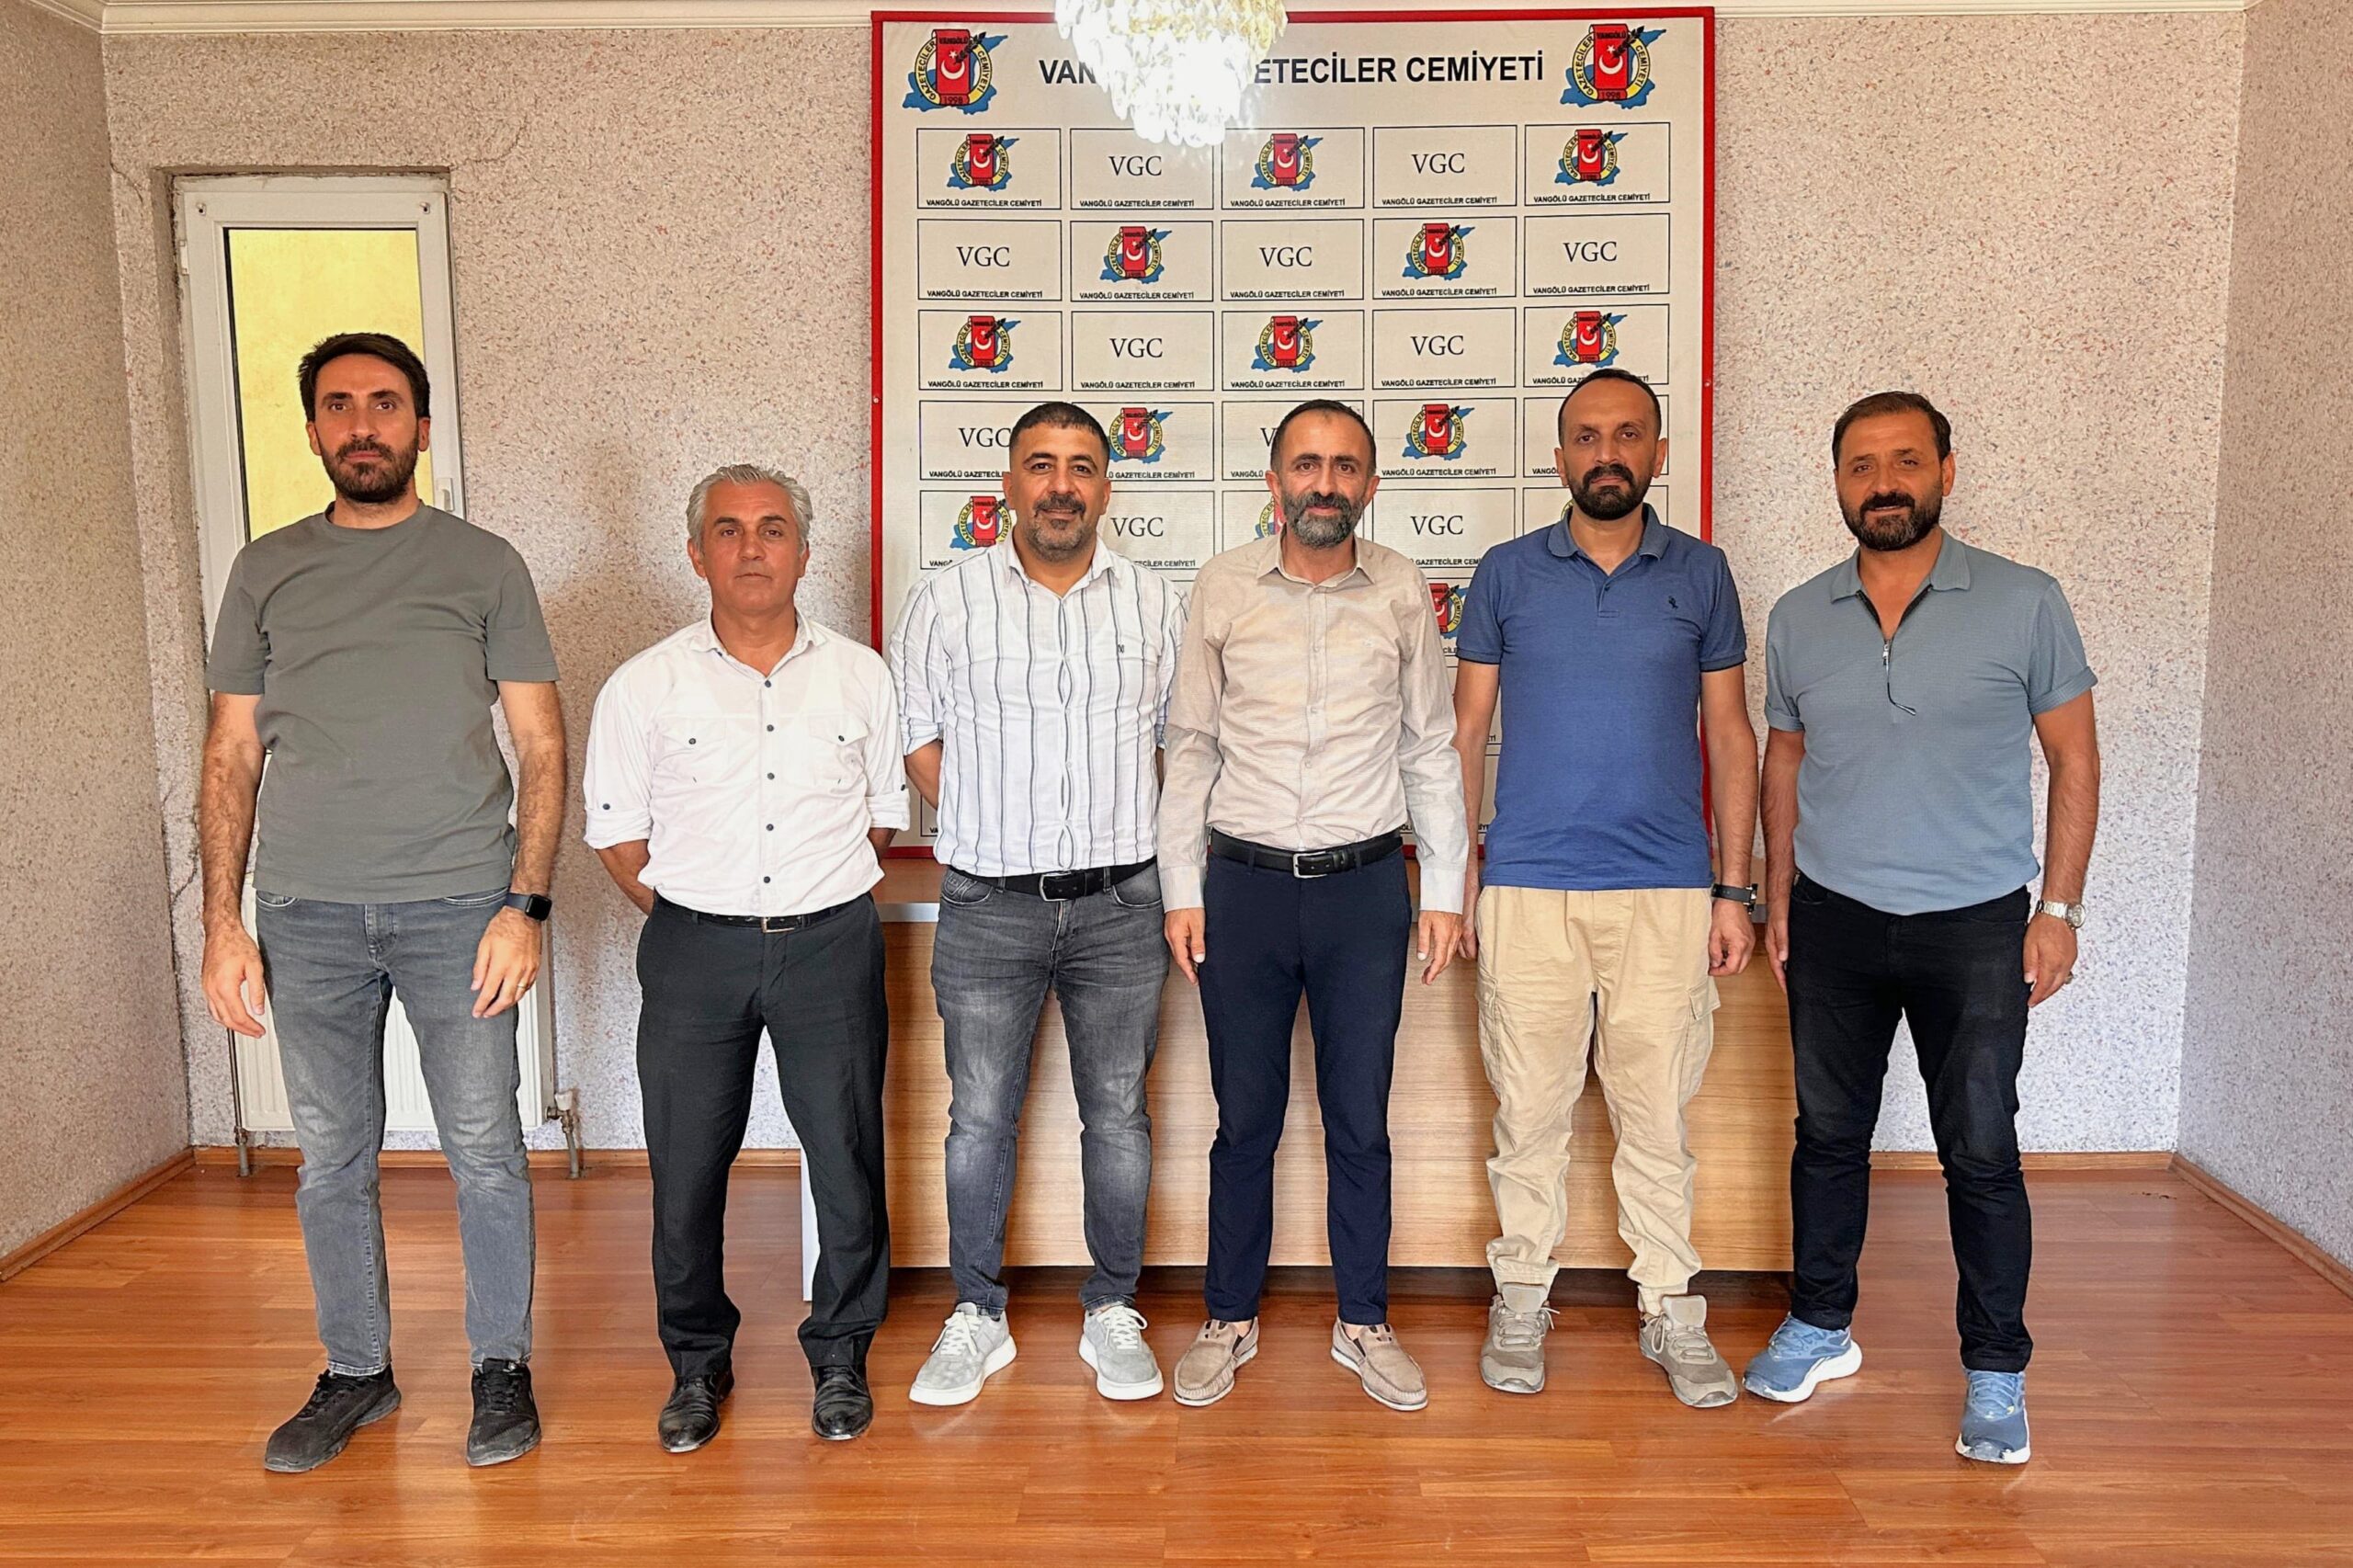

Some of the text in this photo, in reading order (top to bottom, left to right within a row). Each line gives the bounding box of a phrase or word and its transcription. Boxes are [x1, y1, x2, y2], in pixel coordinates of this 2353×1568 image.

[916, 40, 937, 100] GAZETECİLER
[1255, 50, 1543, 83] ETECİLER CEMİYETİ
[1574, 35, 1594, 96] GAZETECİLER
[1636, 46, 1649, 87] CEMİYETİ
[977, 51, 991, 93] CEMİYETİ
[943, 96, 963, 105] 1998
[1600, 91, 1620, 100] 1998
[1109, 156, 1161, 176] VGC
[1412, 153, 1464, 174] VGC
[1416, 197, 1463, 205] GAZETECİLER
[1618, 193, 1651, 201] CEMİYETİ
[926, 199, 960, 207] VANGÖLÜ
[1011, 199, 1042, 207] CEMİYETİ
[1114, 199, 1161, 208] GAZETECİLER
[1231, 199, 1345, 207] VANGÖLÜ GAZETECİLER CEMİYETİ
[957, 247, 1009, 267] VGC
[1259, 247, 1312, 267] VGC
[1563, 242, 1617, 262] VGC
[1416, 288, 1463, 296] GAZETECİLER
[1533, 283, 1650, 294] VANGÖLÜ GAZETECİLER CEMİYETİ
[962, 290, 1009, 299] GAZETECİLER
[1011, 290, 1042, 299] CEMİYETİ
[1114, 291, 1161, 300] GAZETECİLER
[1313, 290, 1344, 298] CEMİYETİ
[1110, 338, 1162, 358] VGC
[1411, 335, 1463, 355] VGC
[963, 381, 1010, 389] GAZETECİLER
[1164, 381, 1195, 389] CEMİYETİ
[1313, 380, 1345, 388] CEMİYETİ
[1416, 379, 1463, 387] GAZETECİLER
[1465, 378, 1496, 386] CEMİYETİ
[959, 427, 1010, 447] VGC
[1111, 517, 1163, 537] VGC
[1411, 516, 1462, 535] VGC
[1415, 557, 1462, 565] GAZETECİLER
